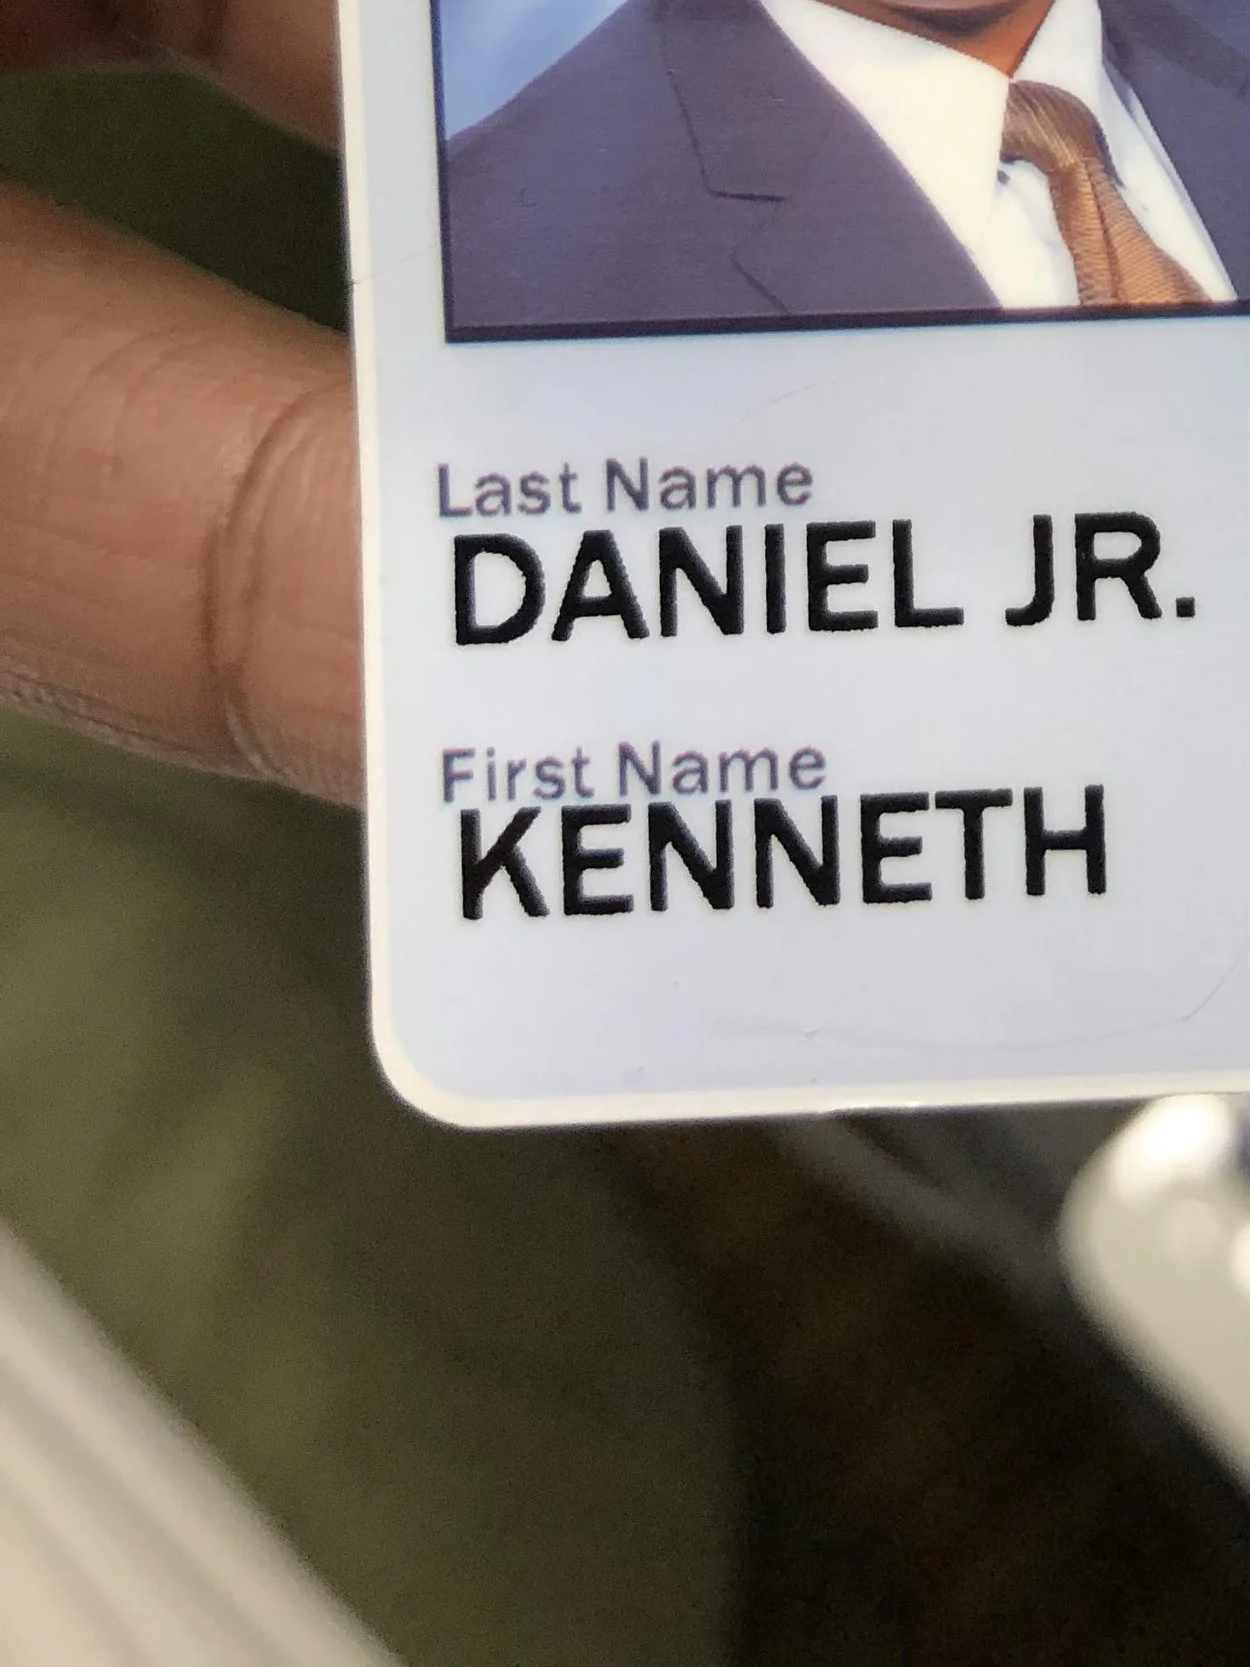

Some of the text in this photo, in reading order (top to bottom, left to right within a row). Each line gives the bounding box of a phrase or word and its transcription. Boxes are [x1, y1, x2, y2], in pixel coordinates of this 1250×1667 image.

[437, 457, 813, 518] Last Name
[454, 511, 1196, 645] DANIEL JR.
[441, 741, 827, 803] First Name
[459, 784, 1107, 920] KENNETH
